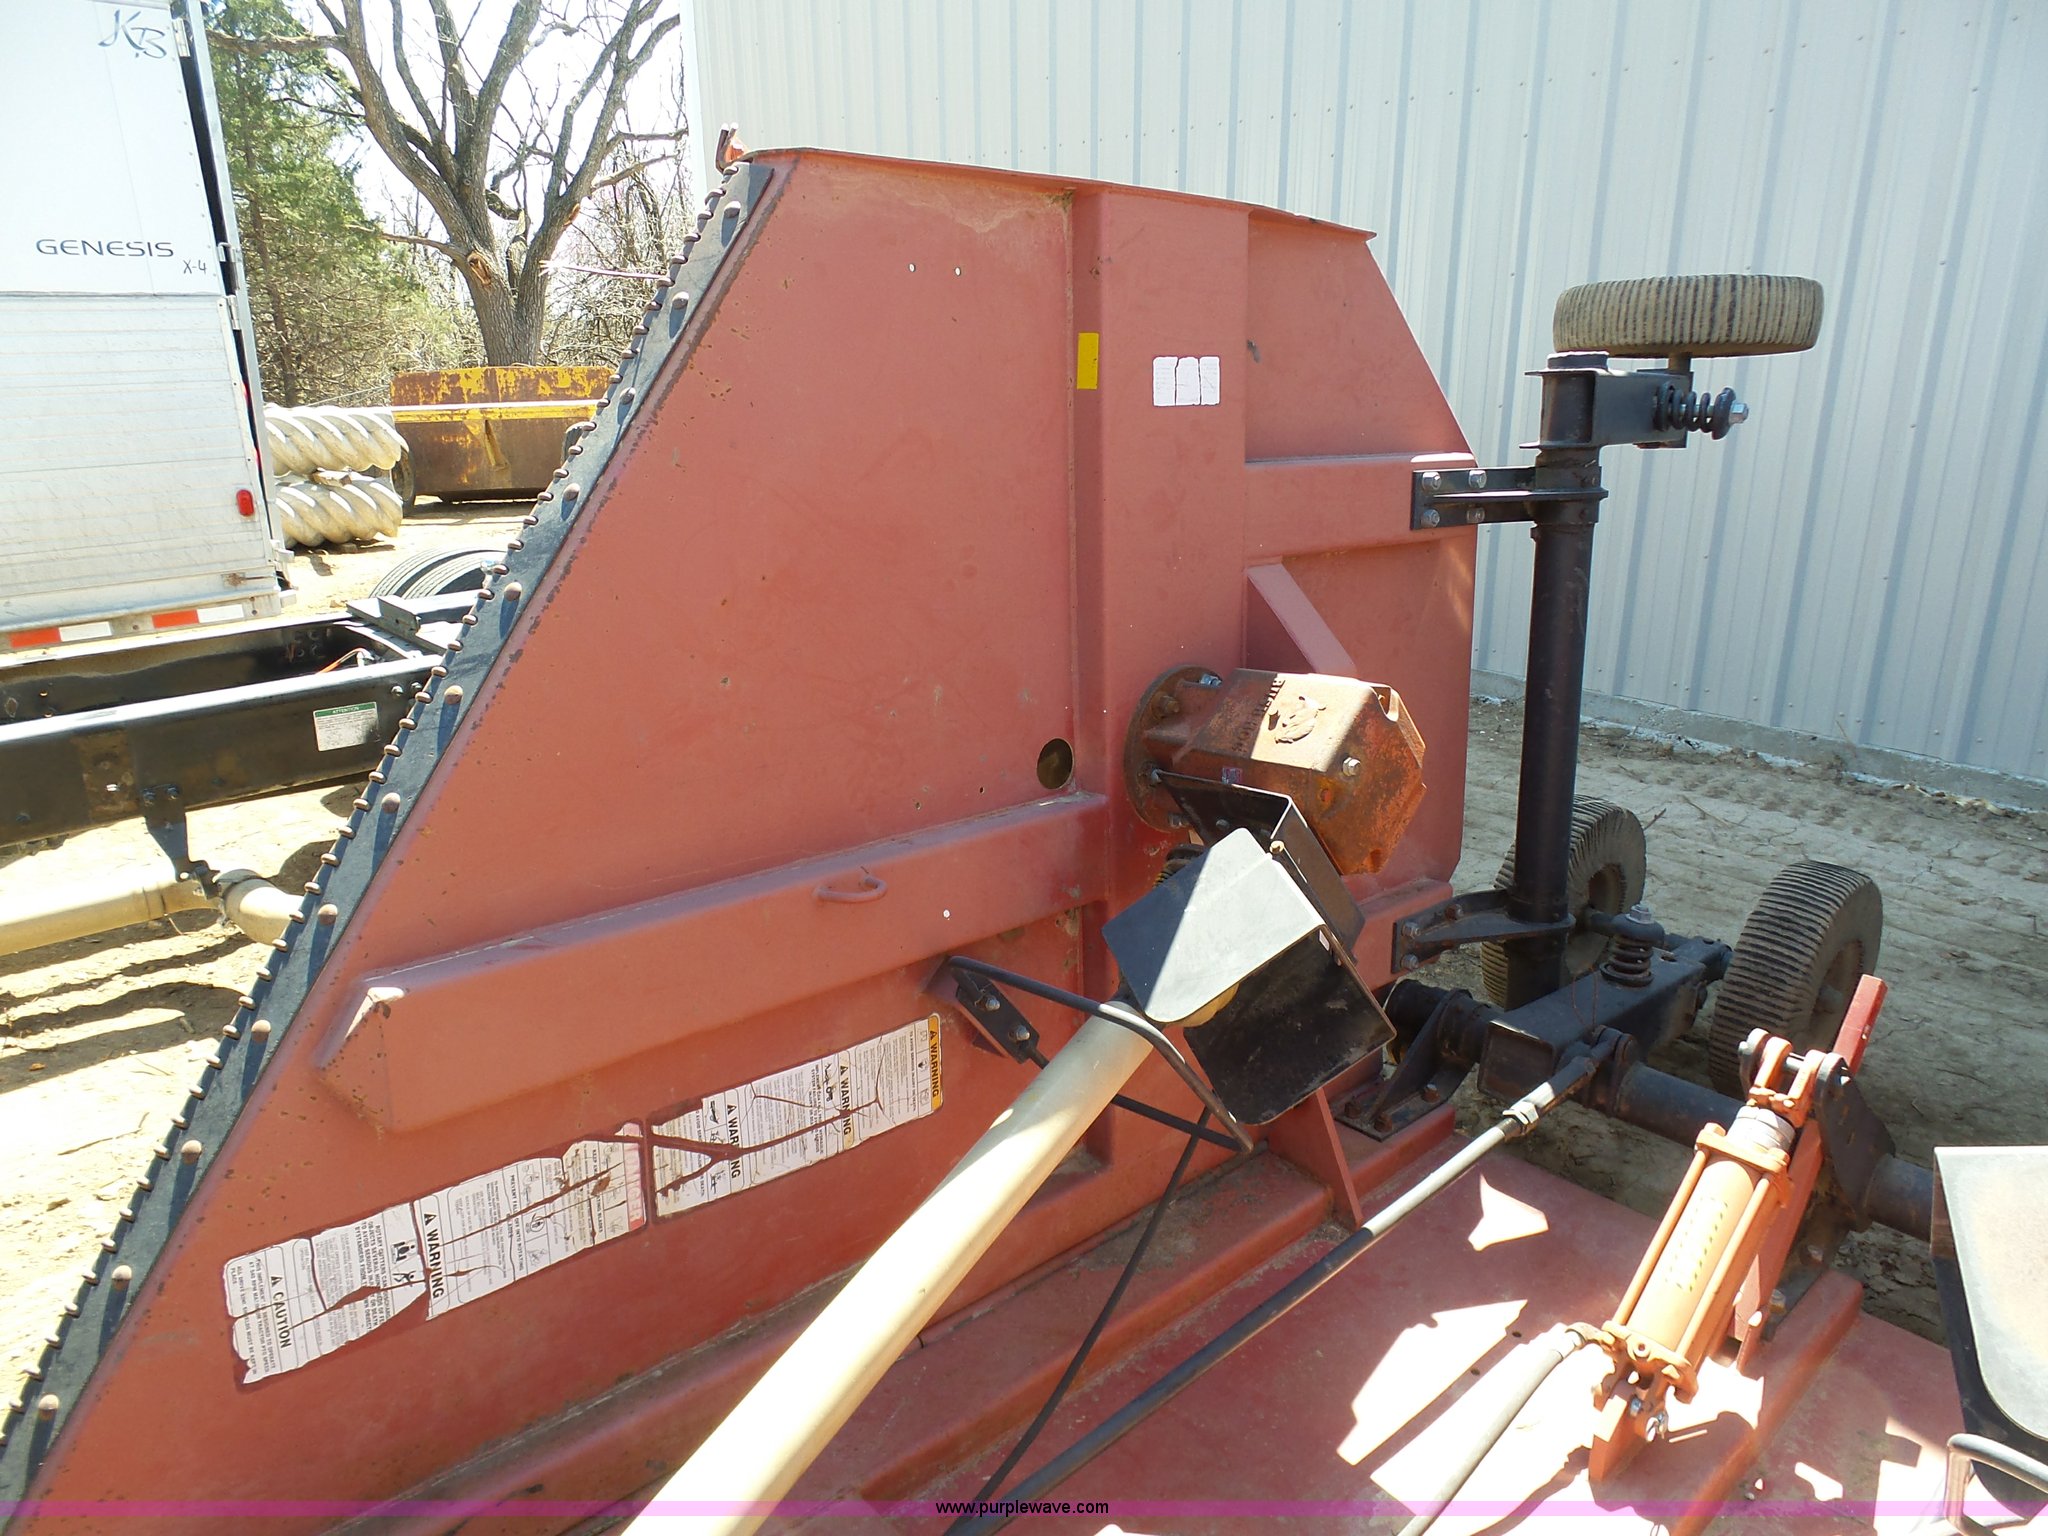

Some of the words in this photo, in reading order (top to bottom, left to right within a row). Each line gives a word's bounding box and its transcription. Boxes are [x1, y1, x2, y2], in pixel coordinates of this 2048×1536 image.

[36, 238, 174, 257] GENESIS
[183, 259, 207, 274] X-4
[930, 1043, 939, 1098] WARNING
[841, 1078, 852, 1135] WARNNG
[728, 1117, 741, 1178] WARNG
[368, 1222, 376, 1246] OBJECTS
[375, 1225, 383, 1247] ROTARY
[364, 1249, 372, 1273] SERIOUS
[371, 1247, 379, 1272] SEVERAL
[378, 1248, 386, 1275] CUTTERS
[427, 1228, 444, 1299] WARNING
[273, 1292, 292, 1348] CAUTION
